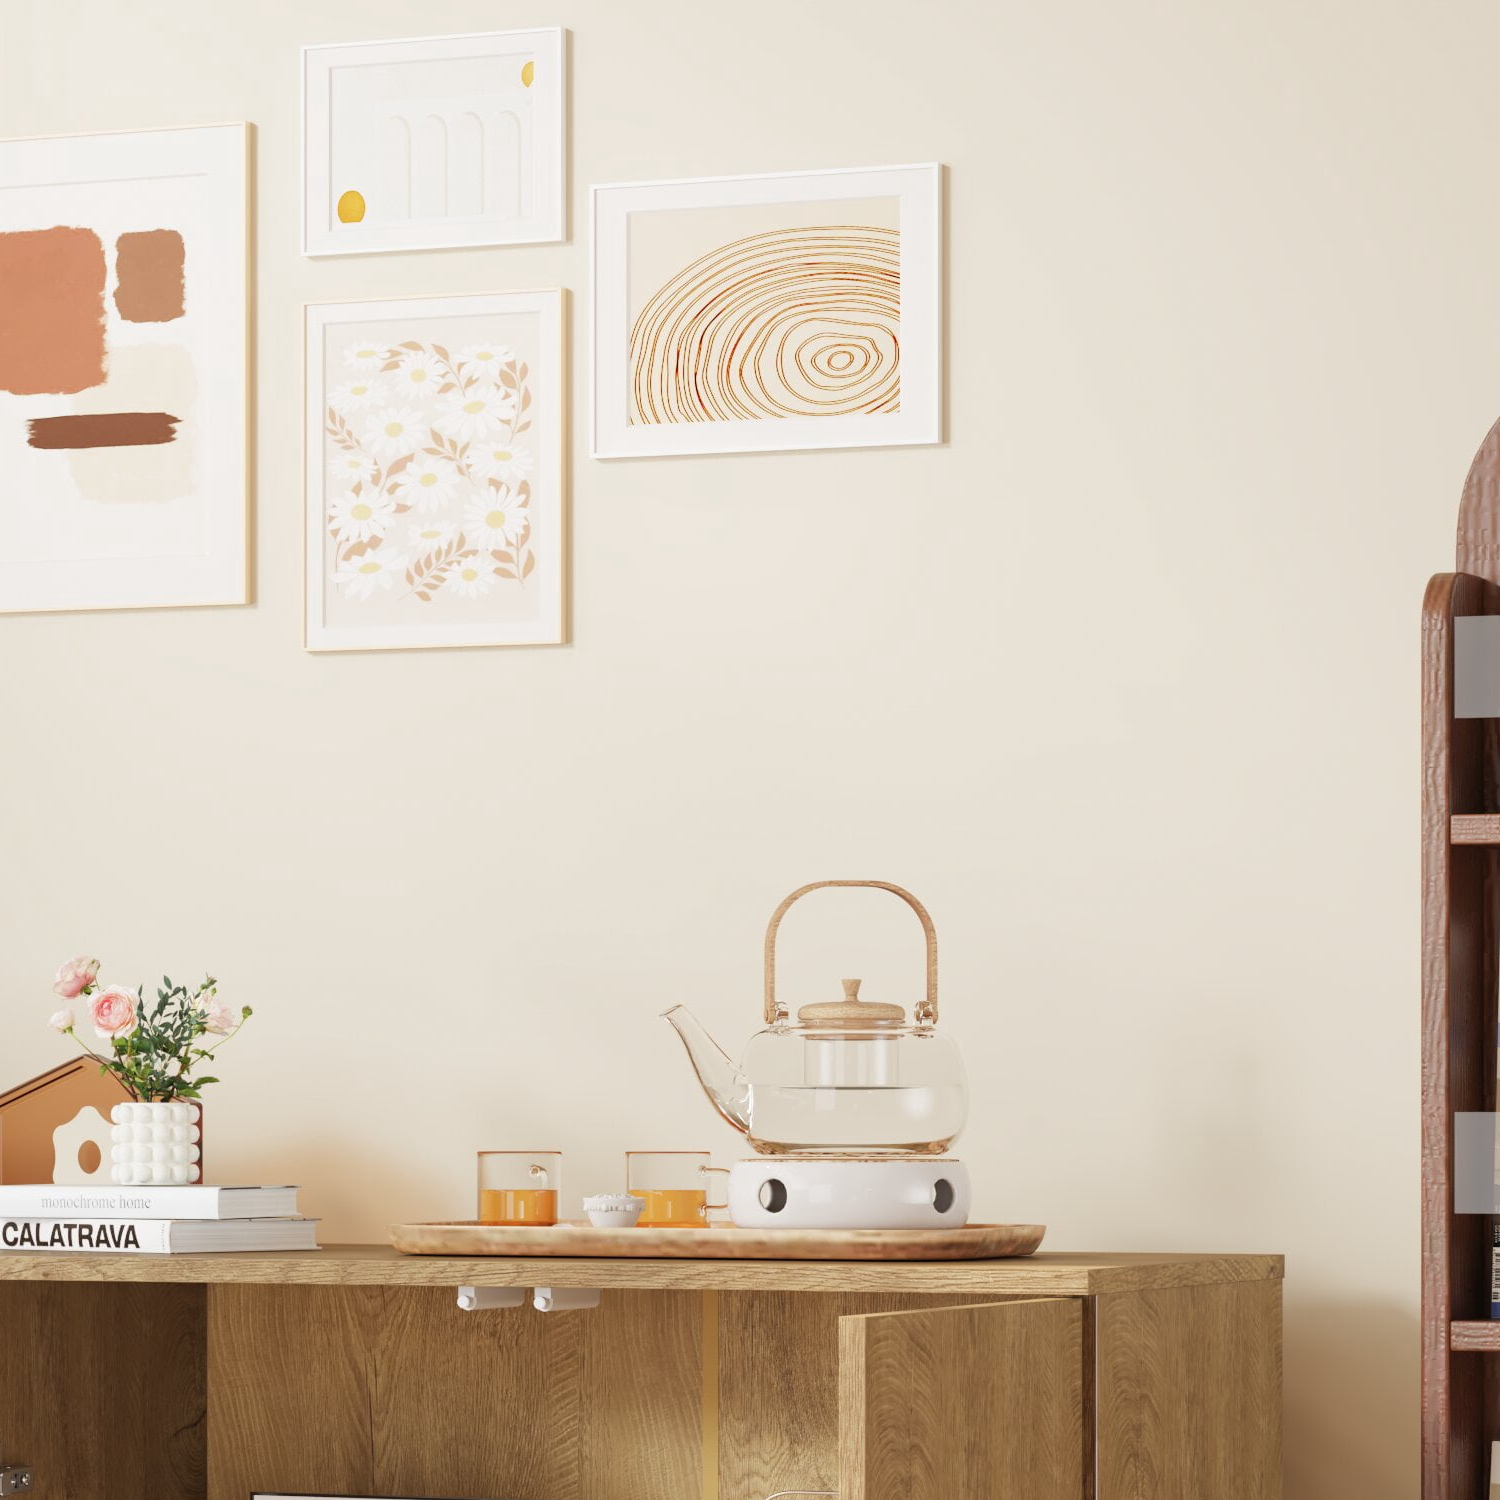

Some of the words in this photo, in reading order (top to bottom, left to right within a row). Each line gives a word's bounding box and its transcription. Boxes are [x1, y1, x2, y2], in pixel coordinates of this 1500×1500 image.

[41, 1195, 116, 1210] monochrome
[119, 1194, 151, 1210] home
[2, 1221, 141, 1249] CALATRAVA
